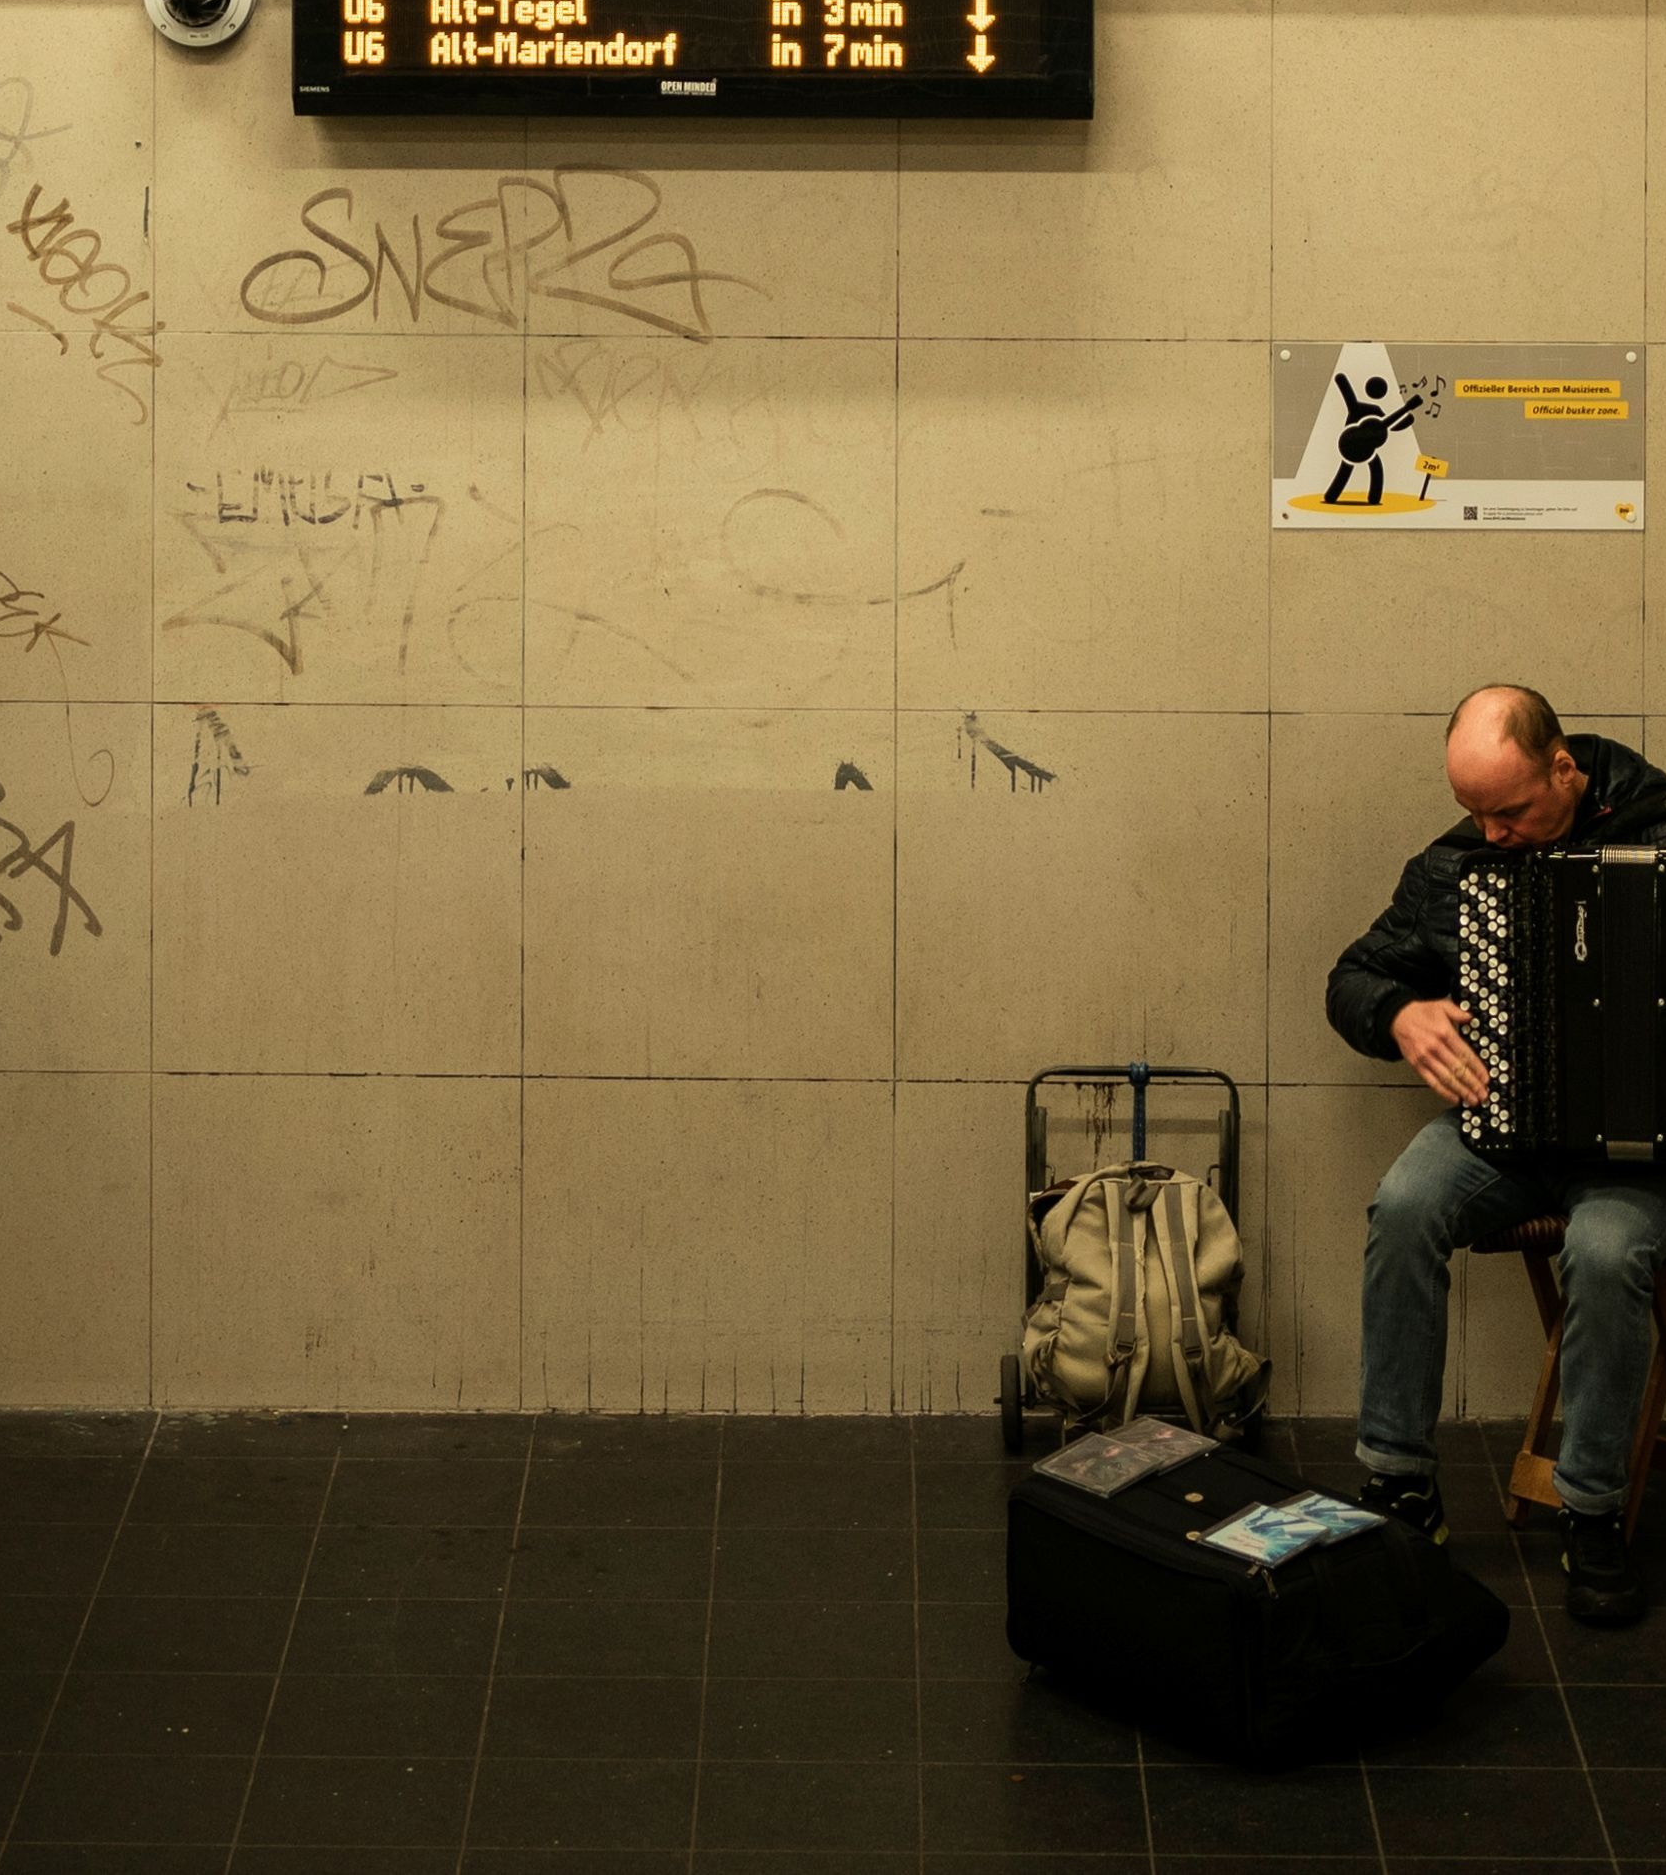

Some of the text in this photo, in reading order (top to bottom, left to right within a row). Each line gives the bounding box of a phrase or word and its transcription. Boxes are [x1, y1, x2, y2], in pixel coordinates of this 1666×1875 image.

[343, 29, 904, 68] U6 Alt-Mariendorf in 7 min
[1462, 383, 1613, 394] Offizieller Bereich zum Musizieren.
[1532, 405, 1565, 415] Official
[1566, 405, 1595, 415] busker
